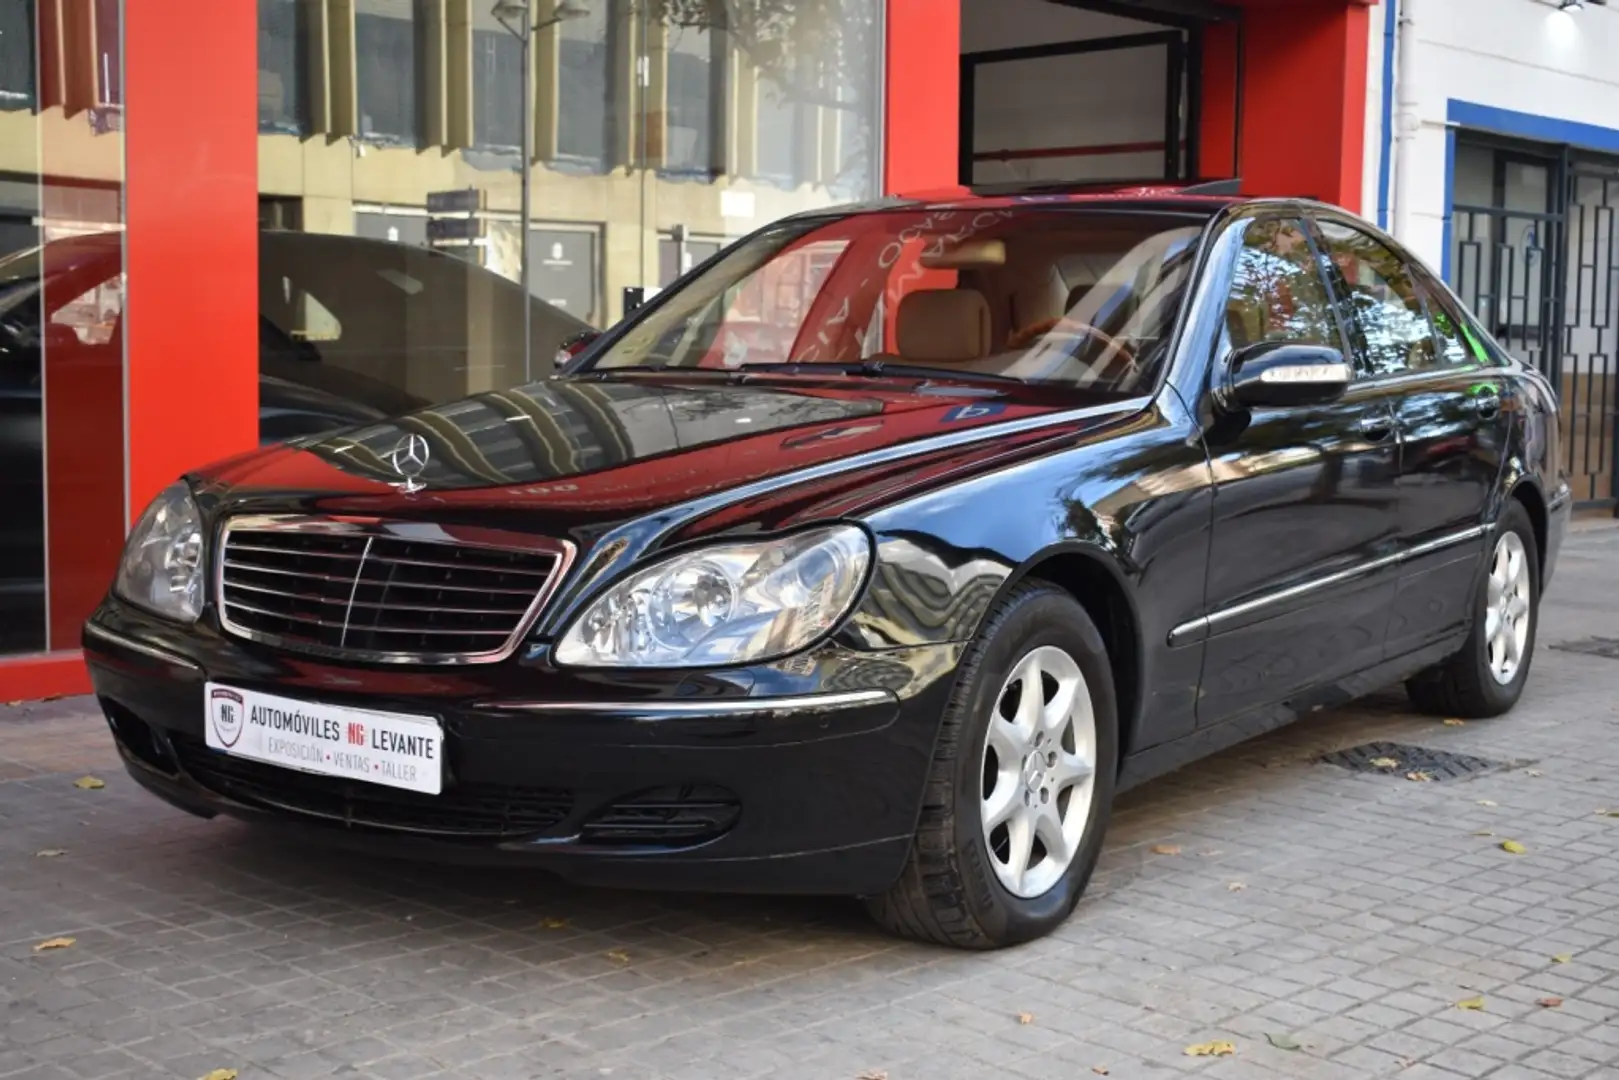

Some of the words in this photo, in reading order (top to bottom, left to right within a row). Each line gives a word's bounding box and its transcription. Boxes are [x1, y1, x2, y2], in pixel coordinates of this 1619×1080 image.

[221, 703, 235, 724] NG
[250, 705, 340, 741] AUTOMÓVILES
[347, 722, 365, 746] NG
[372, 729, 434, 759] LEVANTE
[268, 738, 323, 764] EXPOSICIÓN
[333, 751, 370, 774] VENTAS
[380, 761, 417, 782] TALLER
